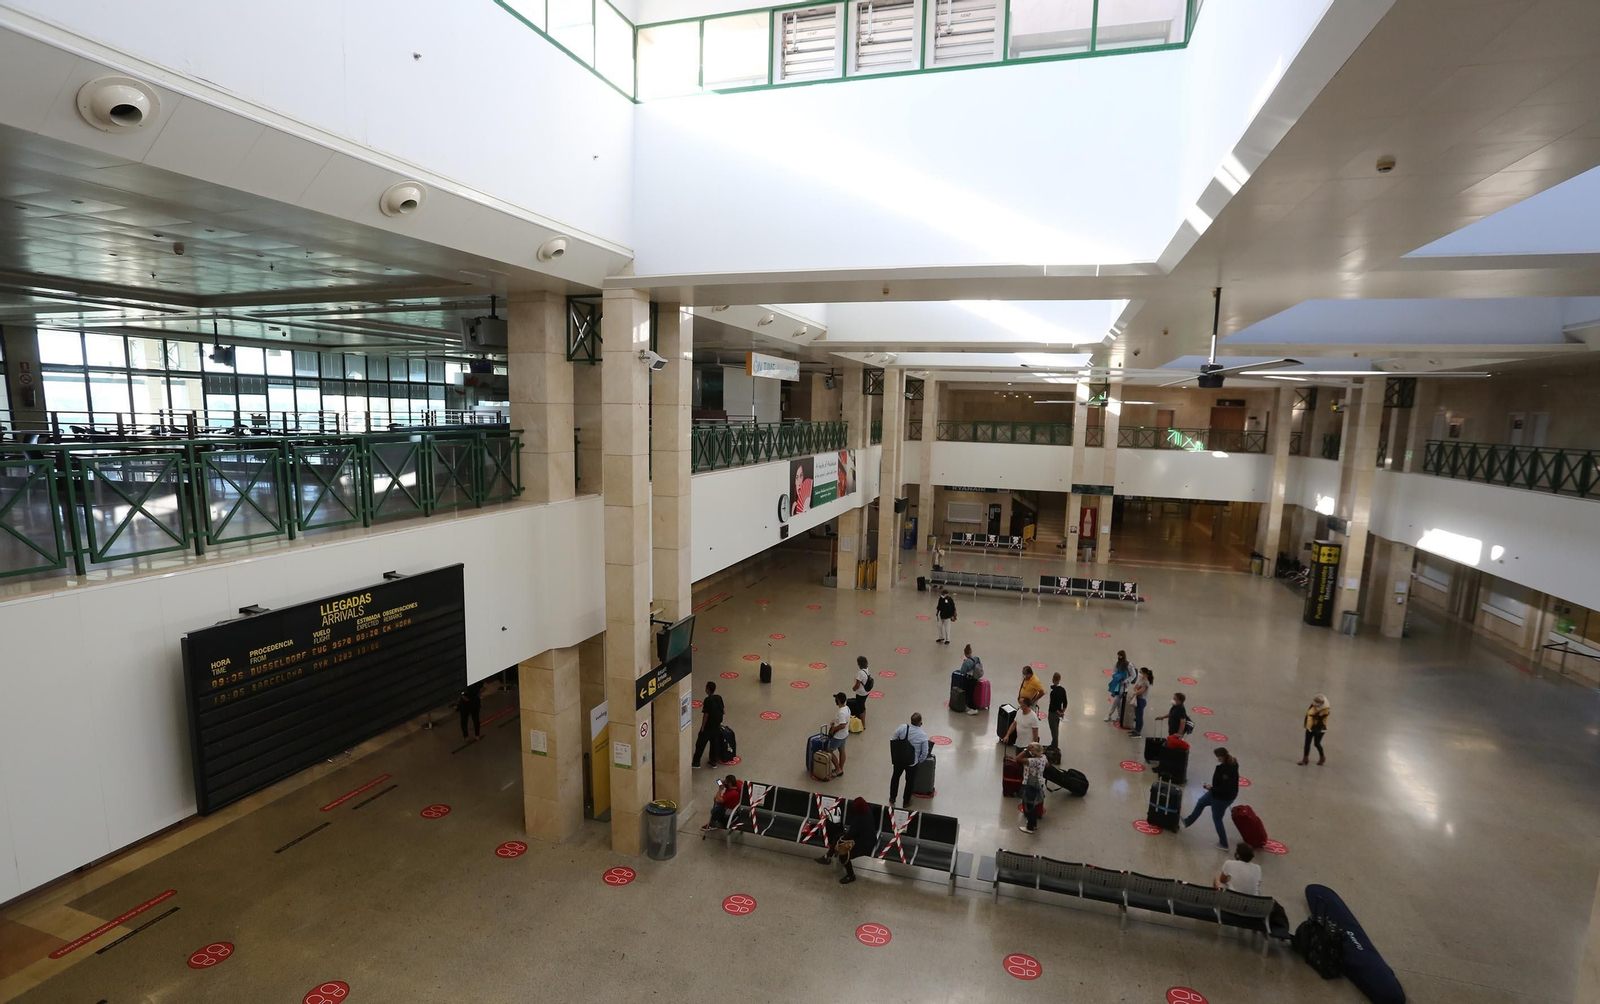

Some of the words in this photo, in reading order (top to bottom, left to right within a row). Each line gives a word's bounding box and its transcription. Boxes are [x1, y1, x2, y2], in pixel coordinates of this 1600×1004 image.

[1320, 566, 1328, 594] encuentro
[1324, 580, 1334, 600] Meeting
[320, 592, 372, 616] LLEGADAS
[1318, 594, 1324, 602] de
[322, 605, 364, 627] ARRIVALS
[1314, 603, 1323, 619] Punto
[211, 658, 231, 669] HORA
[249, 639, 294, 657] PROCEDENCIA
[312, 628, 330, 638] VUELO
[356, 613, 380, 625] ESTIMADA
[382, 602, 418, 617] OBSERVACIONES
[212, 666, 227, 676] TIME
[250, 654, 267, 665] FROM
[313, 634, 330, 644] FLIGHT
[356, 620, 380, 631] EXPECTED
[212, 671, 243, 688] 09:35
[250, 651, 307, 675] DUSSELDORF
[252, 668, 302, 691] BARCELONA
